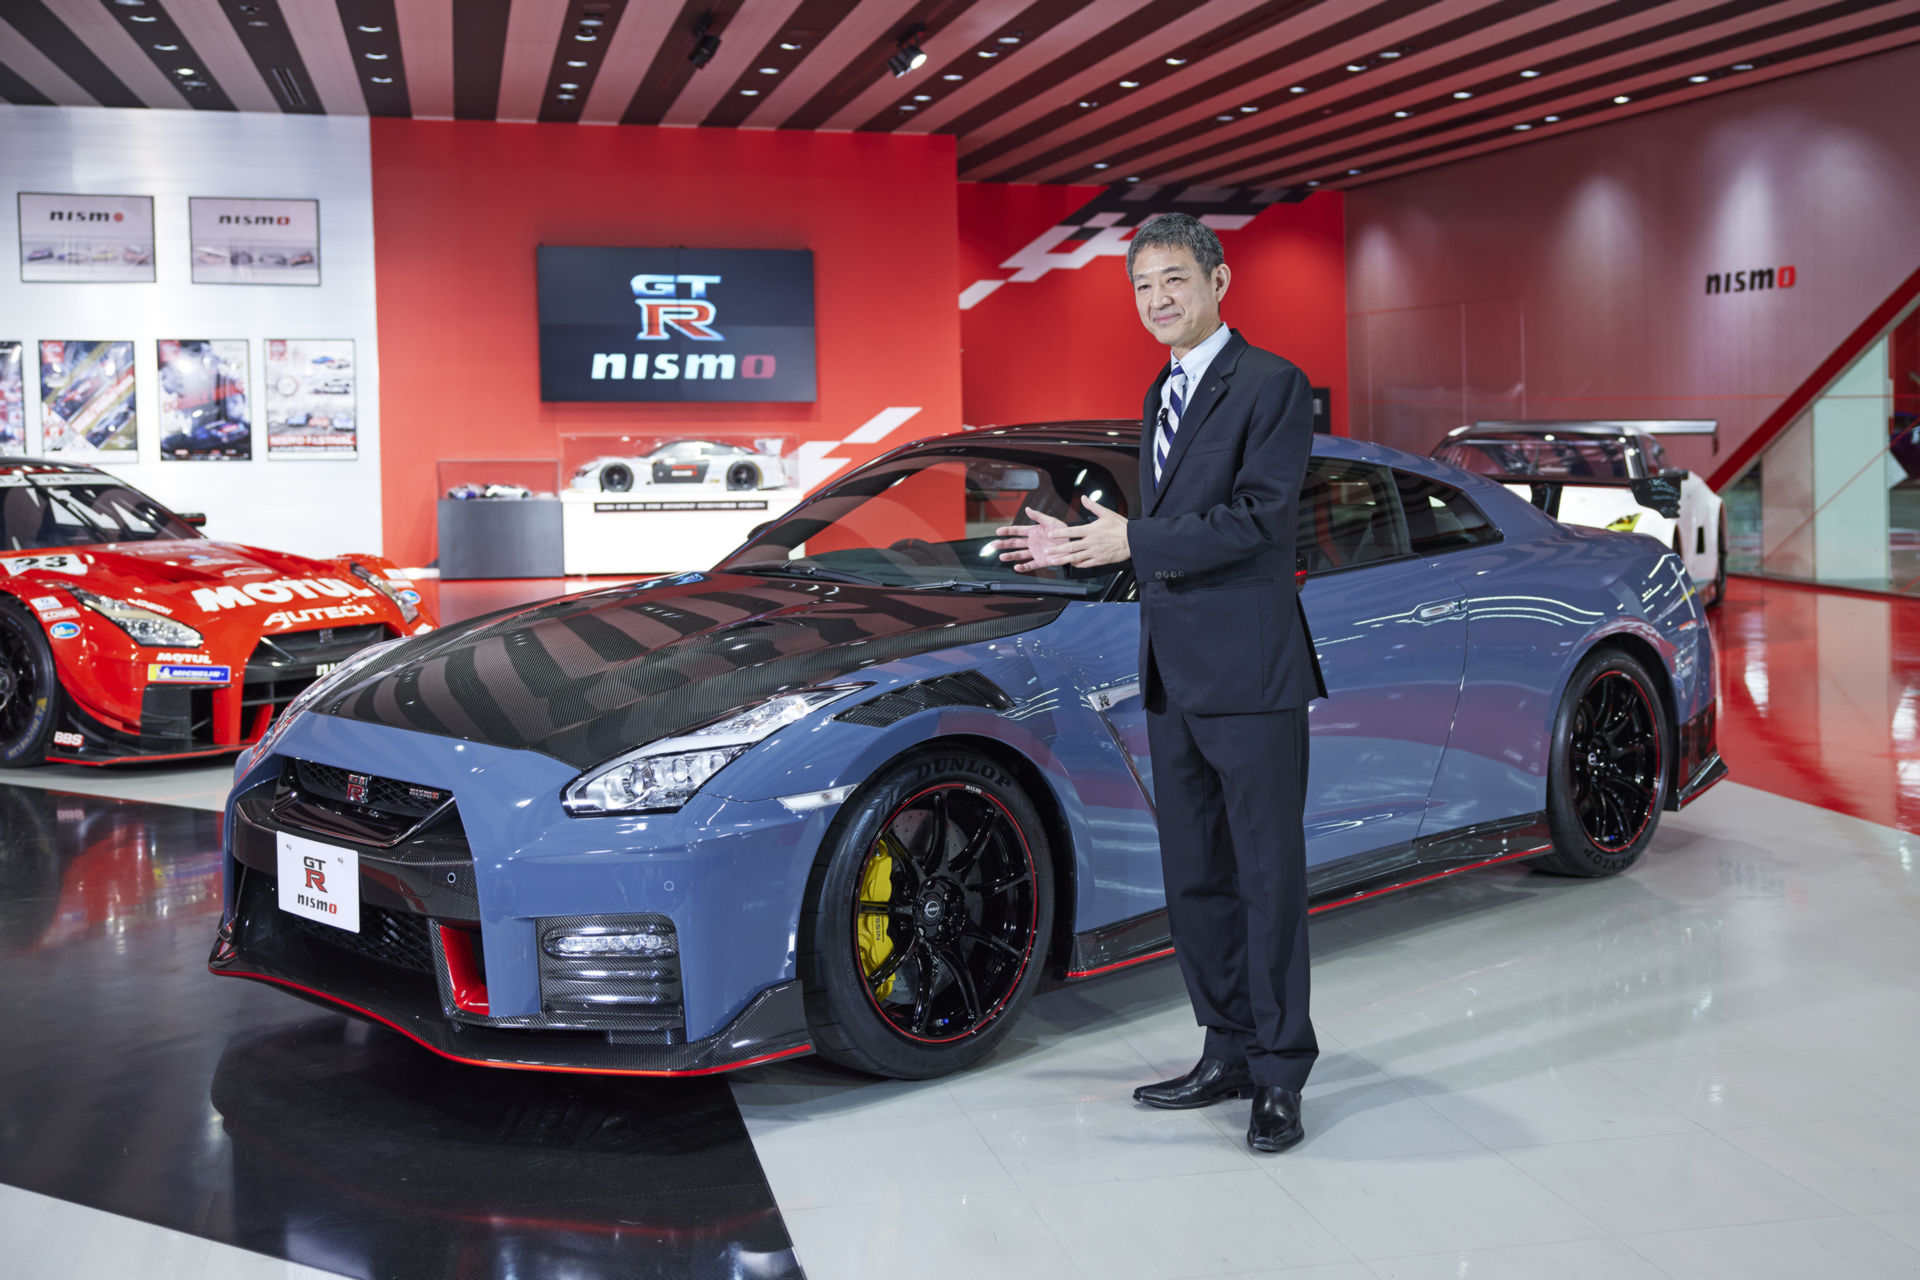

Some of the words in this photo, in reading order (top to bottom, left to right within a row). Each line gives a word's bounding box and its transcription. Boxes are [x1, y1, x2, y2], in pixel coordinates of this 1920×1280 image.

[219, 215, 291, 226] nismo
[630, 274, 722, 298] GT
[1705, 264, 1797, 295] nismo
[634, 298, 726, 341] R
[591, 353, 777, 380] nismo
[15, 556, 67, 567] 23
[191, 578, 376, 612] MOTUL
[263, 603, 376, 629] AUTECH
[156, 652, 213, 664] MOTUL
[54, 731, 83, 747] BBS
[918, 758, 1012, 788] DUNLOP
[303, 856, 326, 871] GT
[304, 868, 329, 893] R
[297, 893, 338, 915] nismo
